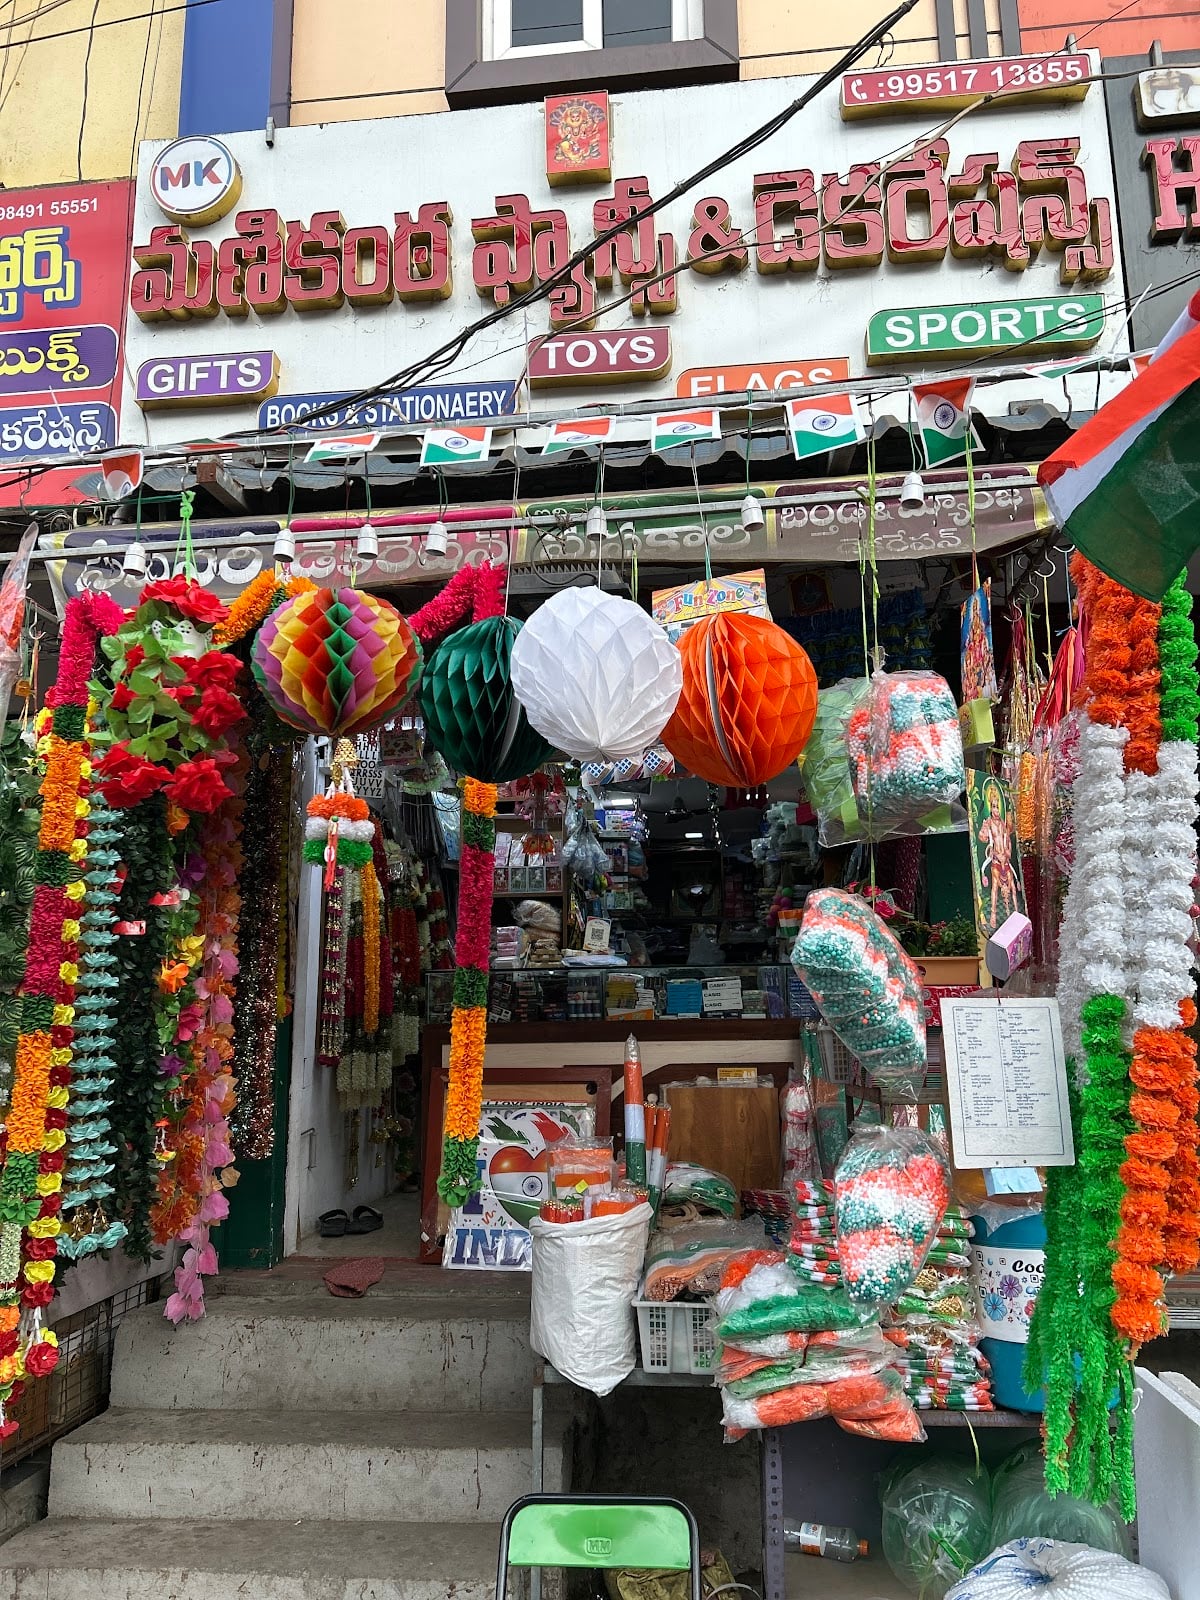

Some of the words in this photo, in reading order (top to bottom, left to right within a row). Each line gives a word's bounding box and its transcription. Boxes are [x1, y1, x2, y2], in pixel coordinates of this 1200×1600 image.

[990, 60, 1083, 87] 13855
[160, 157, 222, 191] MK
[50, 198, 98, 215] 55551
[131, 201, 452, 315] మణికంఠ
[687, 196, 742, 263] &
[885, 301, 1090, 348] SPORTS
[541, 336, 656, 369] TOYS
[147, 358, 262, 394] GIFTS
[690, 367, 833, 397] FLAGS
[344, 405, 359, 426] &
[364, 389, 507, 426] STATIONAERY
[673, 592, 704, 614] Fun
[706, 587, 745, 605] Zone
